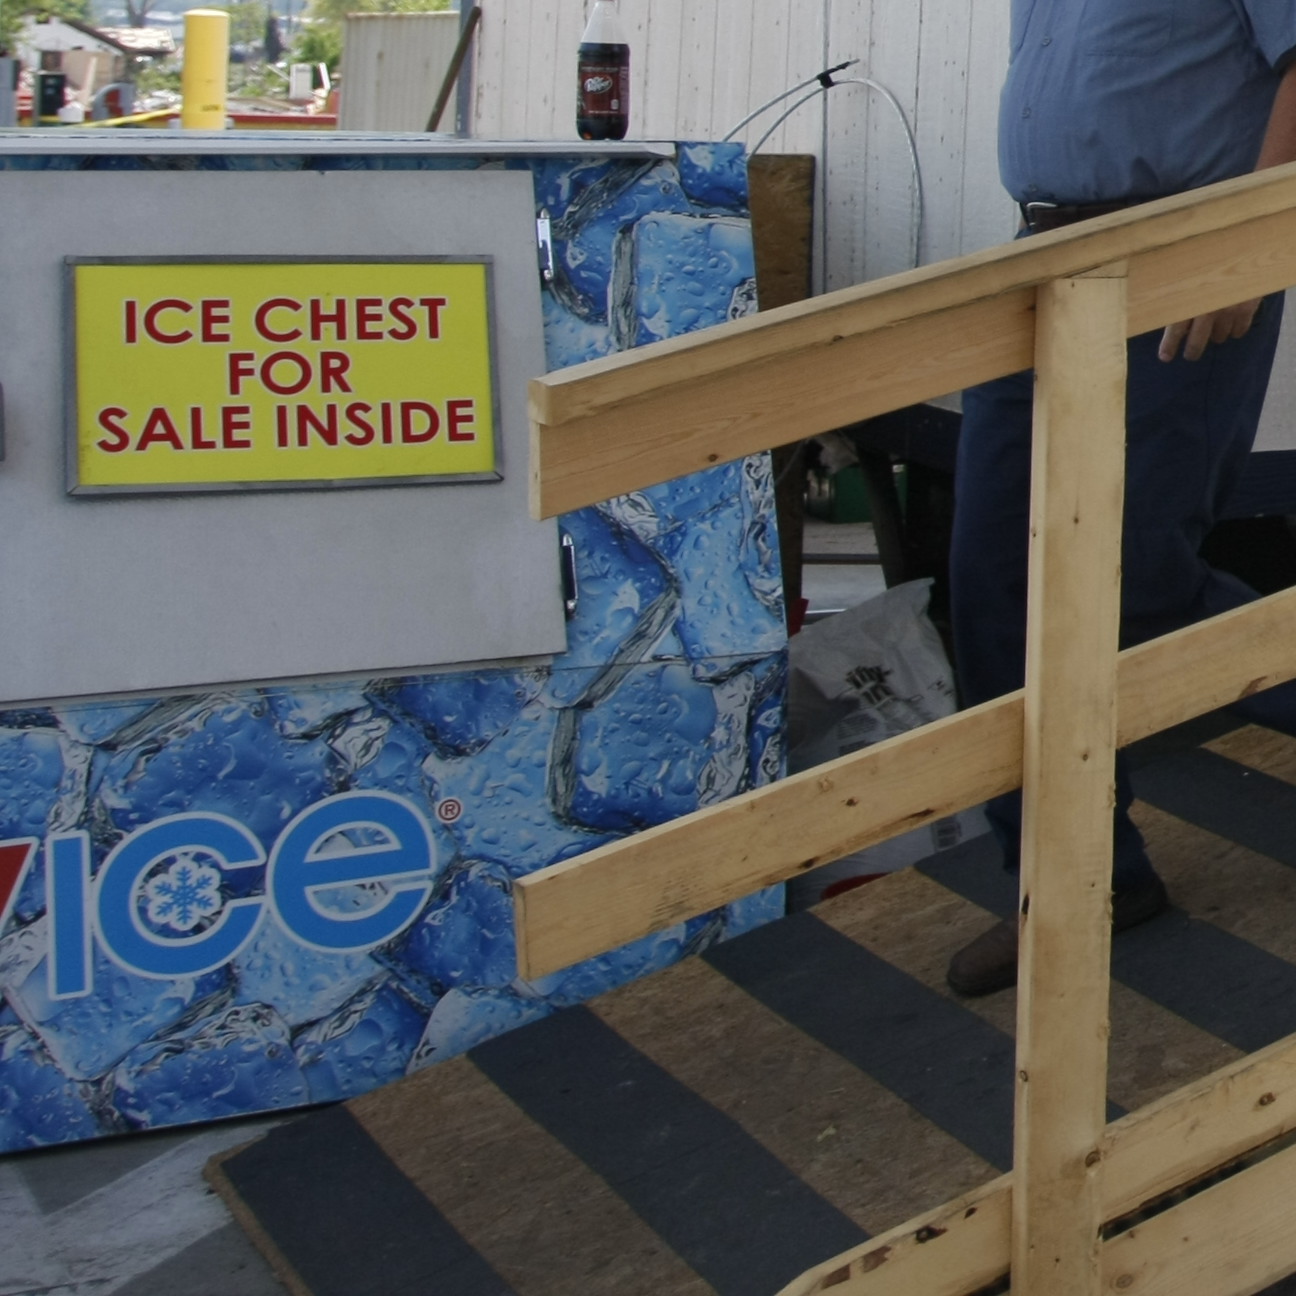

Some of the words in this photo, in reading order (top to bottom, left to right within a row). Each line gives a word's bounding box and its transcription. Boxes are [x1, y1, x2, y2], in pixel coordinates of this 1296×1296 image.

[124, 299, 232, 344] ICE
[254, 297, 446, 343] CHEST
[228, 350, 352, 396] FOR
[97, 405, 252, 453] SALE
[275, 399, 476, 448] INSIDE
